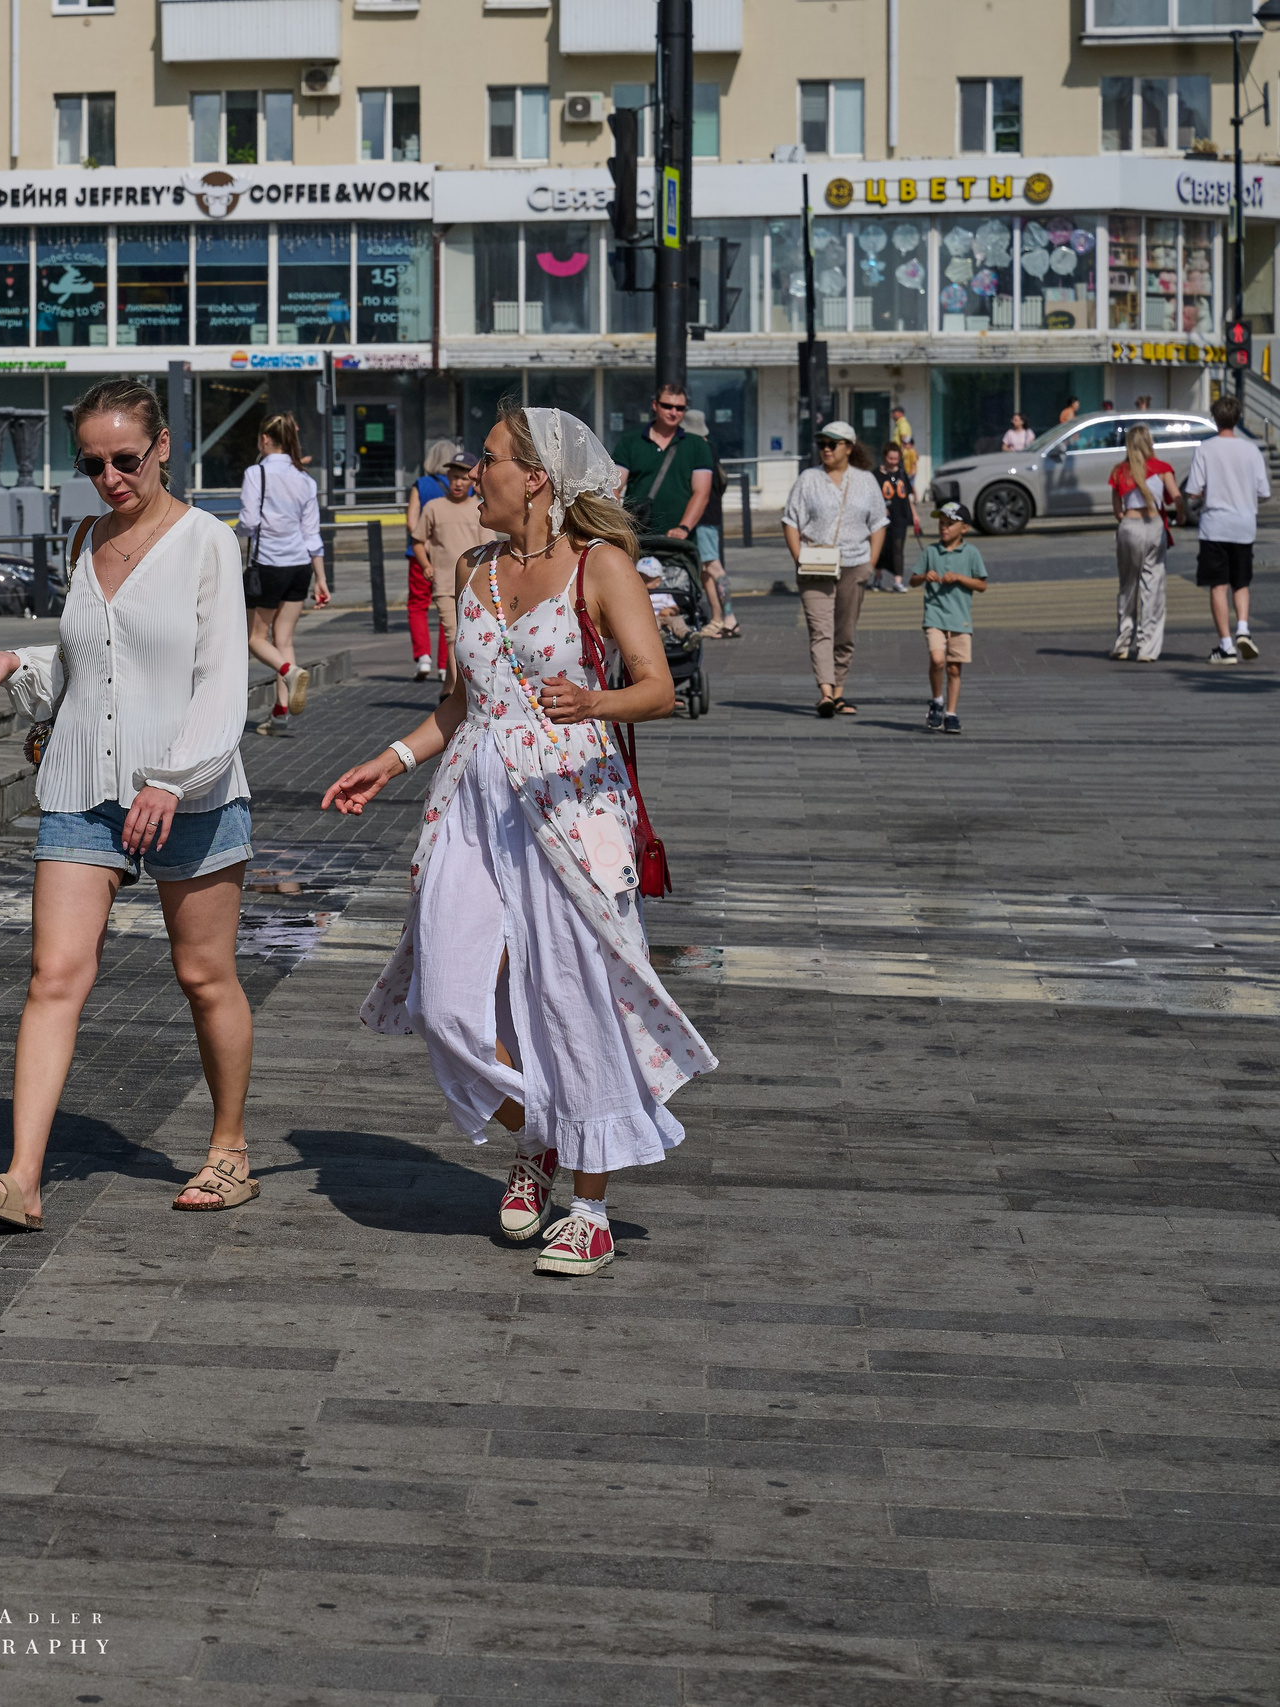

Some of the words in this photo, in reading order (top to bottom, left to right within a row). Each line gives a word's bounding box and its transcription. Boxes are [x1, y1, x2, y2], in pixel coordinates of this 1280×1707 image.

[74, 185, 186, 207] JEFFREY'S
[865, 176, 1013, 206] ЦВЕТЫ
[37, 301, 75, 318] coffee
[76, 305, 89, 317] to
[90, 300, 106, 316] go
